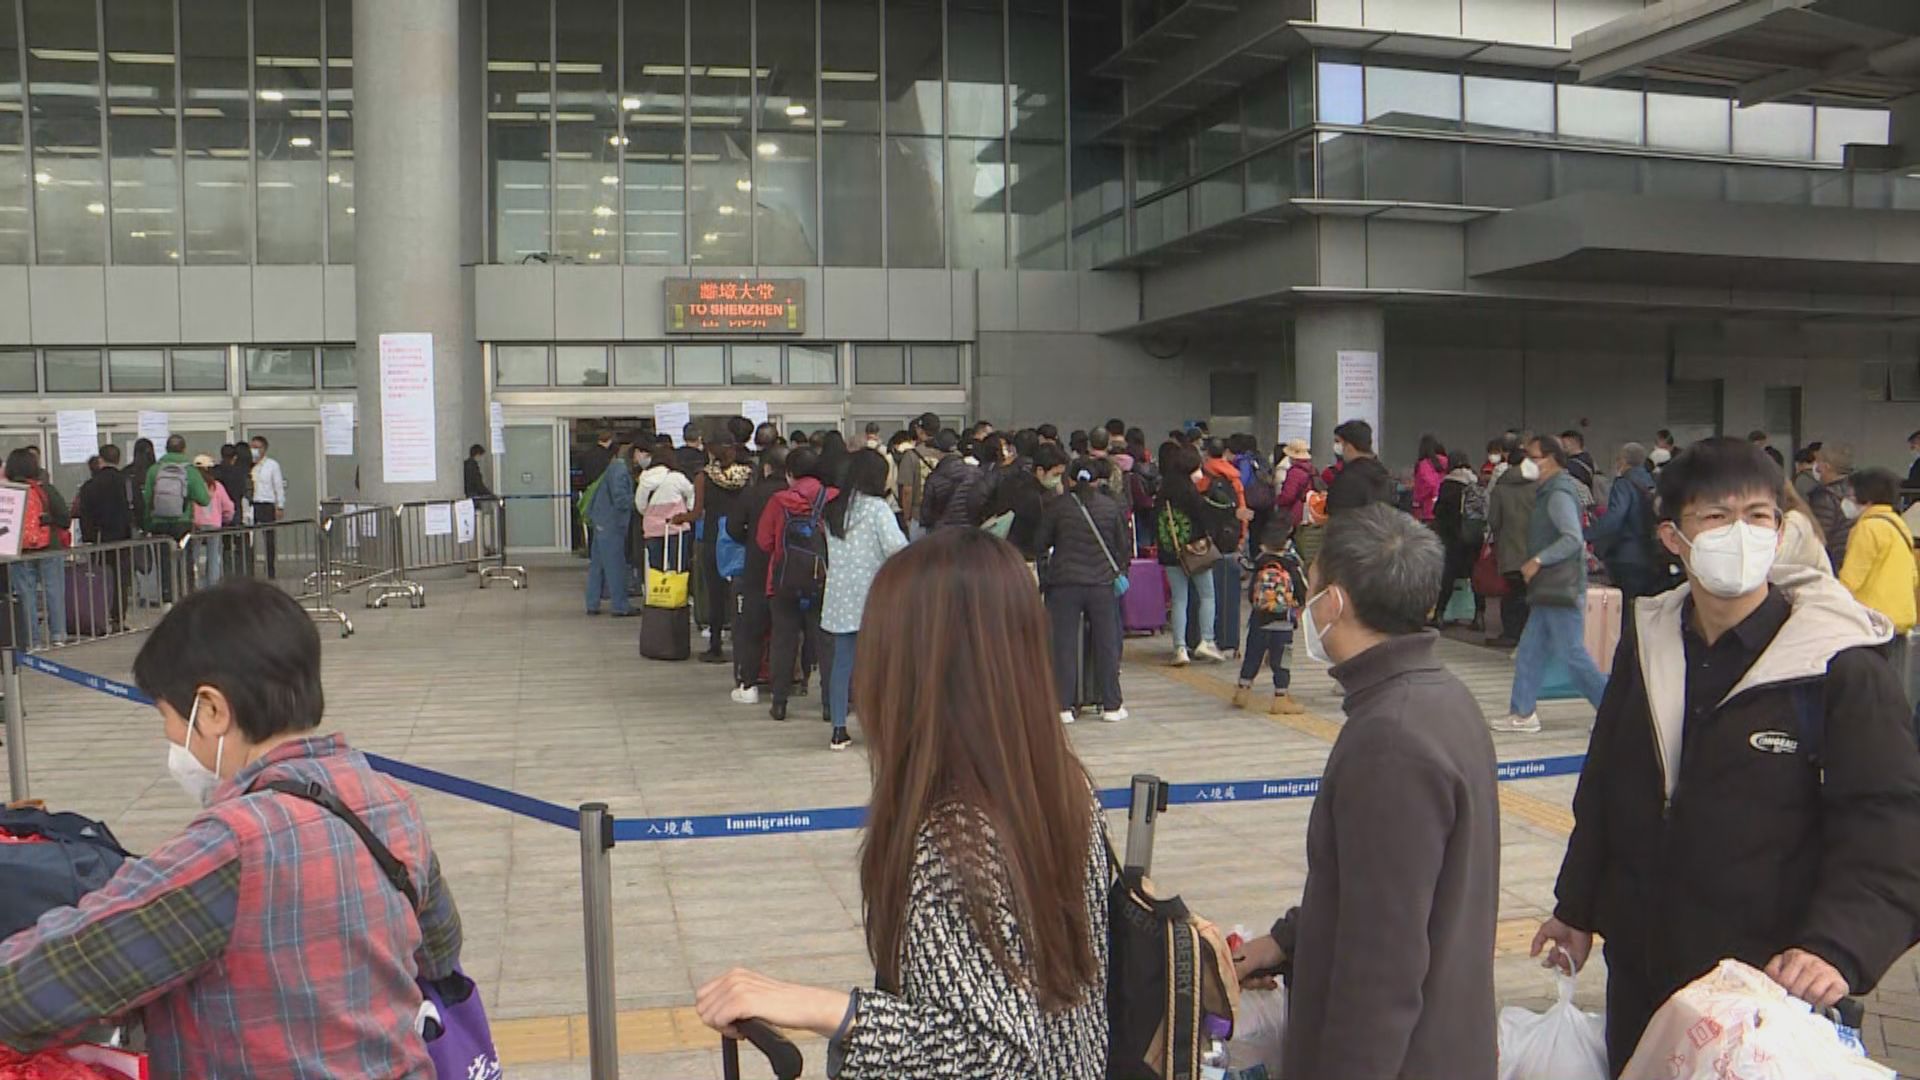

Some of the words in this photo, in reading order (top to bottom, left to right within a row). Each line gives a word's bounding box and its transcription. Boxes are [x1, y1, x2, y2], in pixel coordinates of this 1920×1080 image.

[689, 304, 707, 316] TO
[710, 303, 784, 316] SHENZHEN
[1497, 762, 1546, 778] migration
[1262, 780, 1319, 795] Immigrati
[647, 819, 695, 836] 入境處
[725, 814, 810, 831] Immigration
